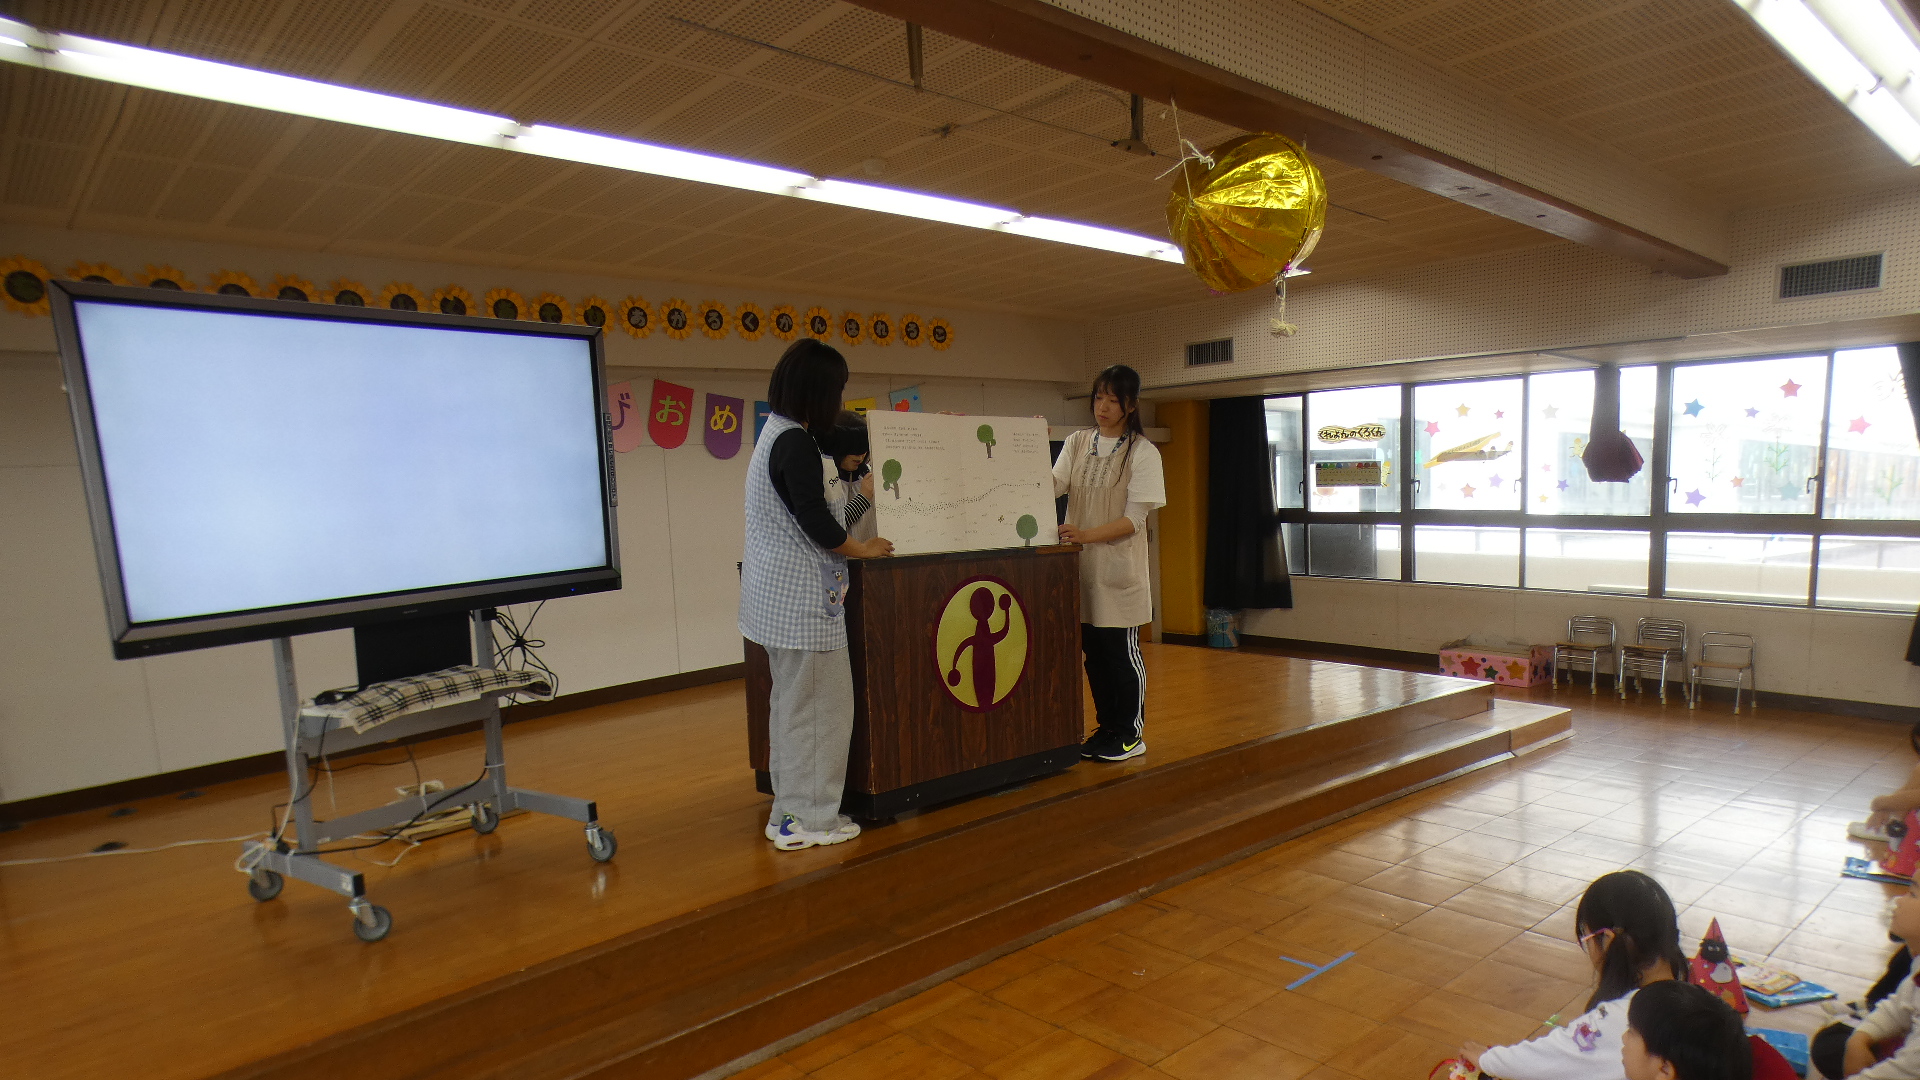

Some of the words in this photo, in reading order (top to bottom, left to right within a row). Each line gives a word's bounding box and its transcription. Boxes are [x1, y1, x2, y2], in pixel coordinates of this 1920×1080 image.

[1319, 426, 1385, 439] くれよんのくろくん
